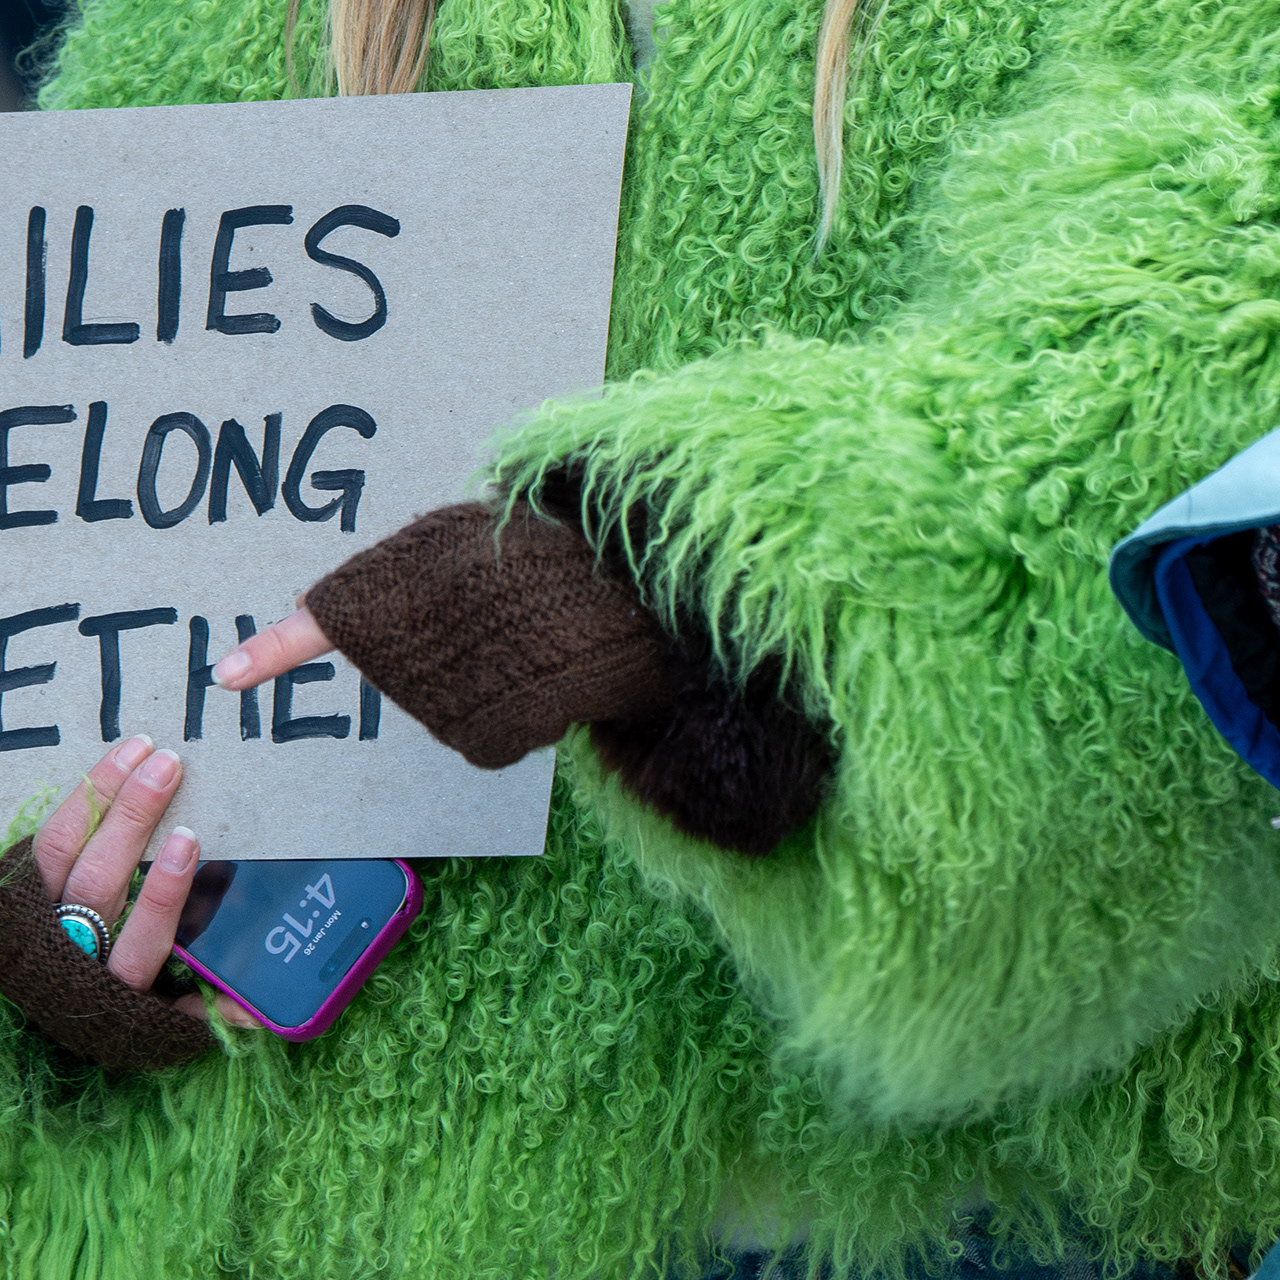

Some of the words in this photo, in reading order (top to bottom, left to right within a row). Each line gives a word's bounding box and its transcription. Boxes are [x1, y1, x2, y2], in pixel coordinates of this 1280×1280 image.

[264, 872, 337, 964] 4:15
[324, 909, 342, 929] Mon
[312, 927, 327, 945] Jan
[303, 942, 317, 956] 26
